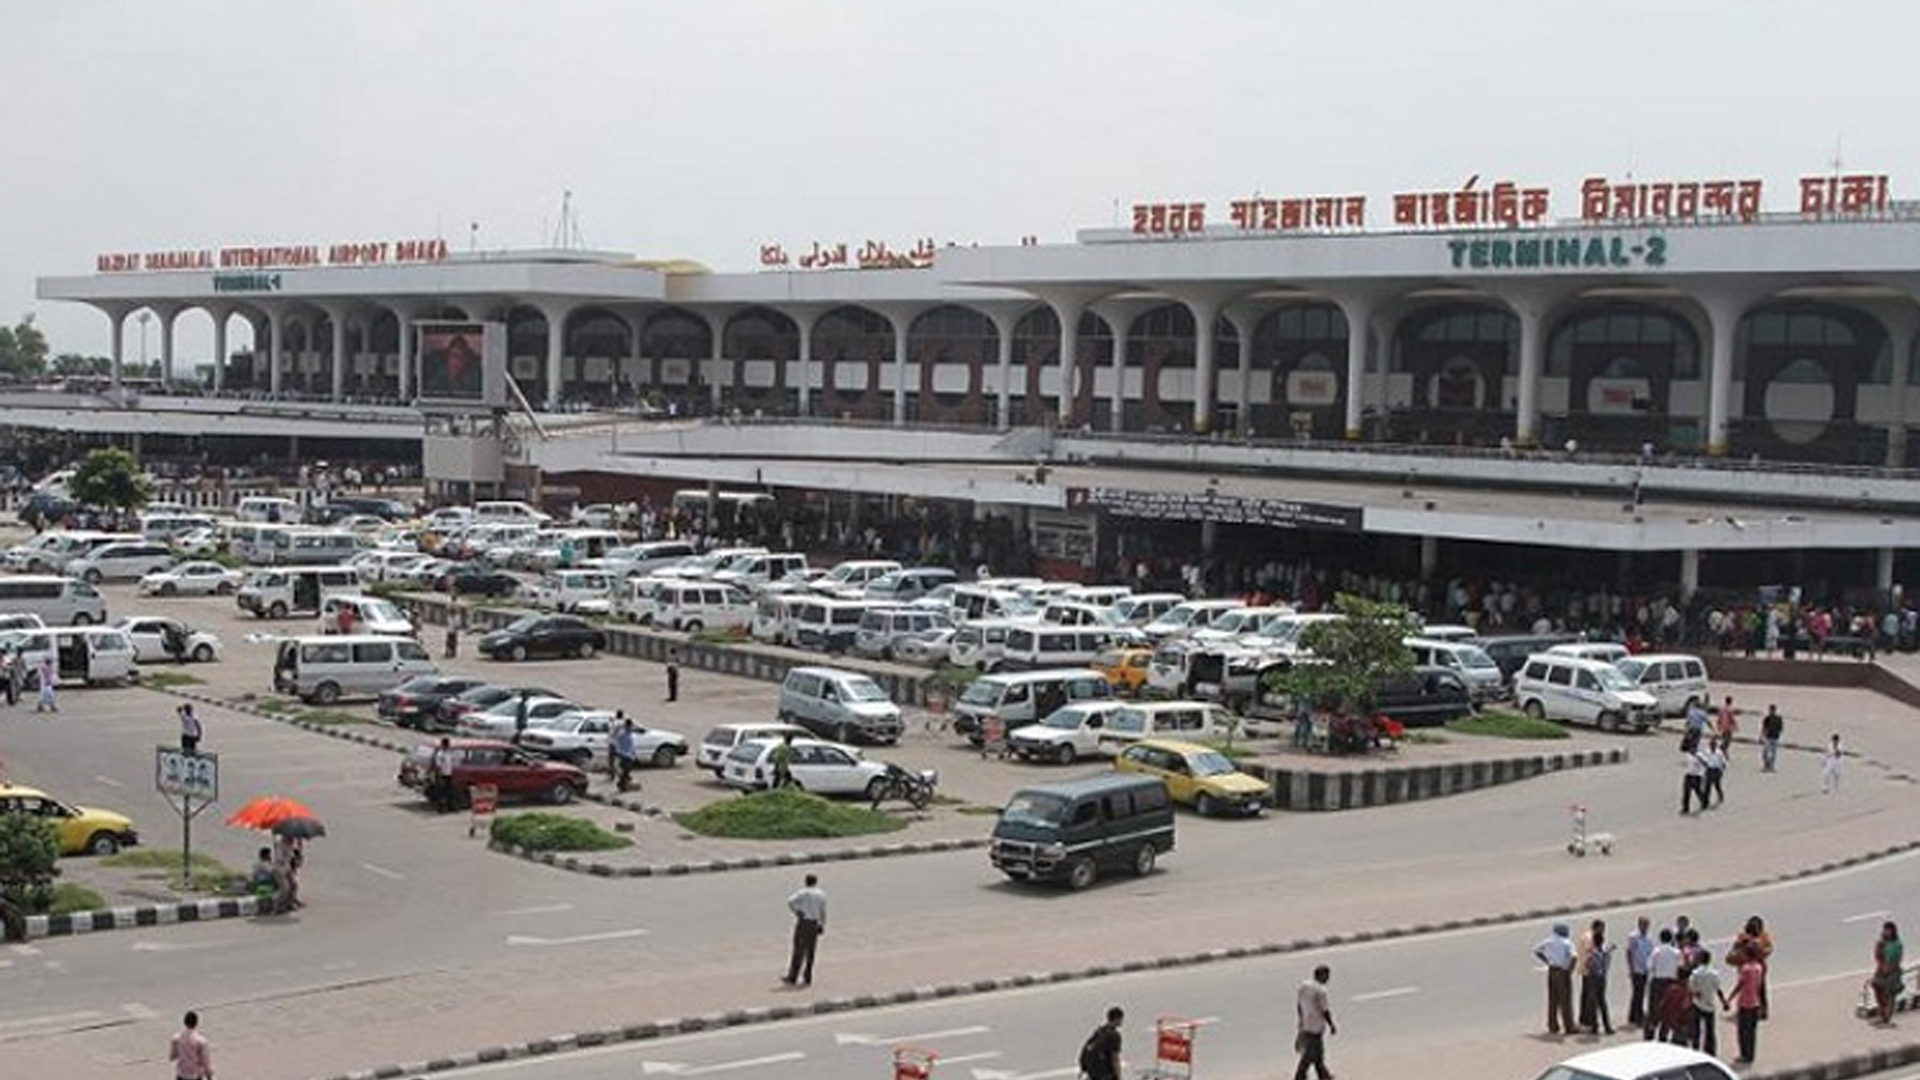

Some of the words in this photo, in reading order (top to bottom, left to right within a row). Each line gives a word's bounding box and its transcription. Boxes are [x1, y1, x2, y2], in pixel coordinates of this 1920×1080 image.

[1799, 175, 1888, 213] ঢাকা
[220, 245, 321, 267] INTERNATIONAL
[328, 242, 388, 264] AIRPORT
[397, 240, 447, 261] DHAKA
[1448, 237, 1666, 268] TERMINAL-2
